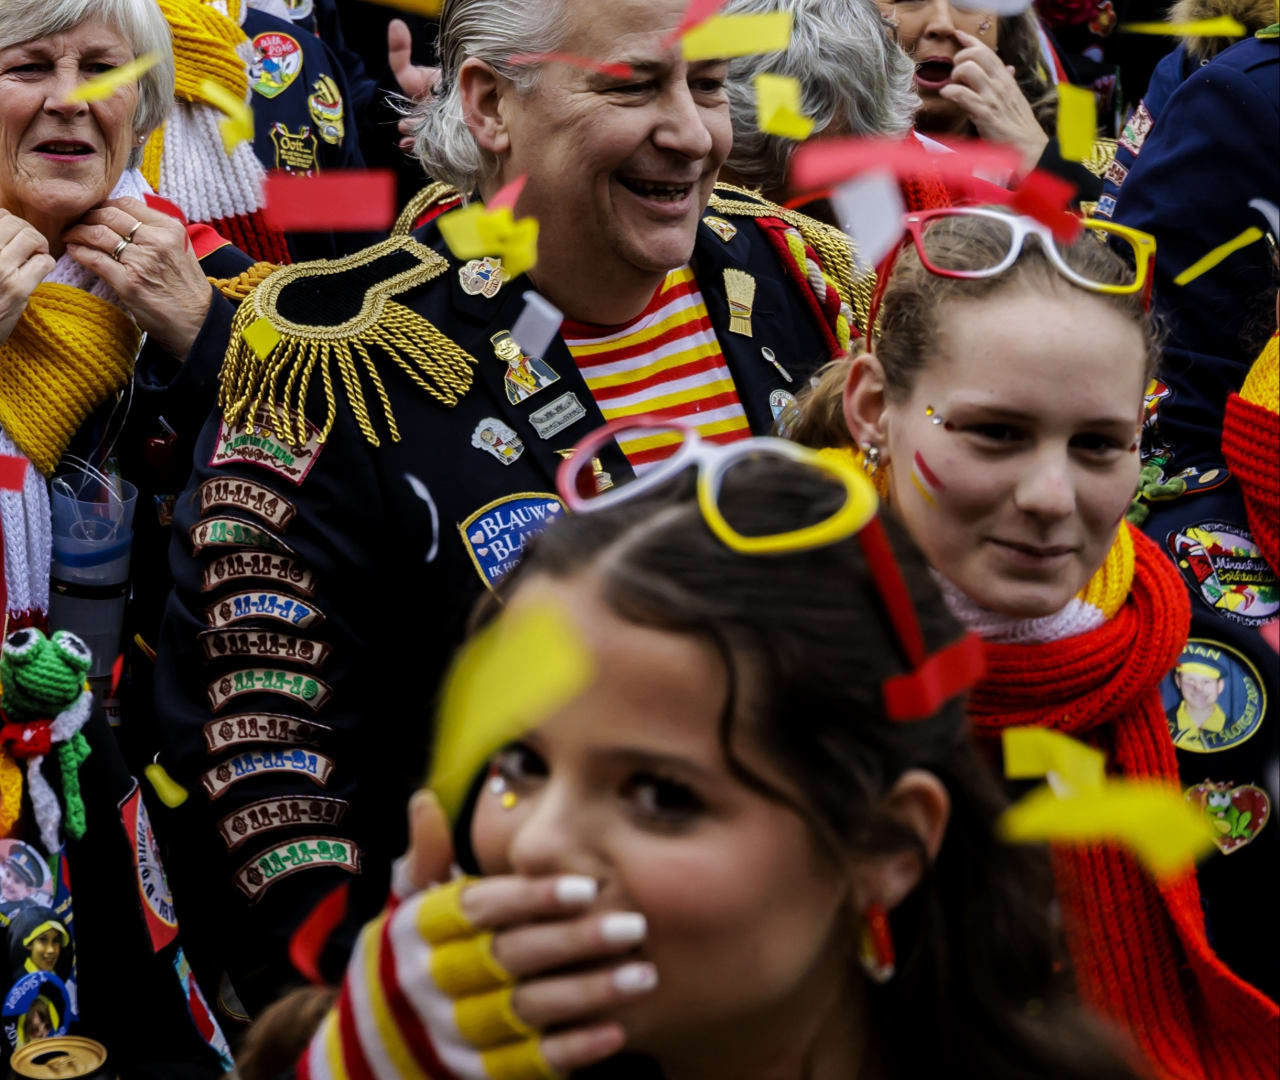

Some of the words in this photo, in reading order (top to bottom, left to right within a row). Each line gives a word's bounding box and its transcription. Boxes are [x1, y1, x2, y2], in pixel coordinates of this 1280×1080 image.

[213, 481, 280, 517] 11-11-14
[478, 504, 546, 540] BLAUW
[488, 564, 503, 578] IK
[234, 594, 310, 624] 11-11-17
